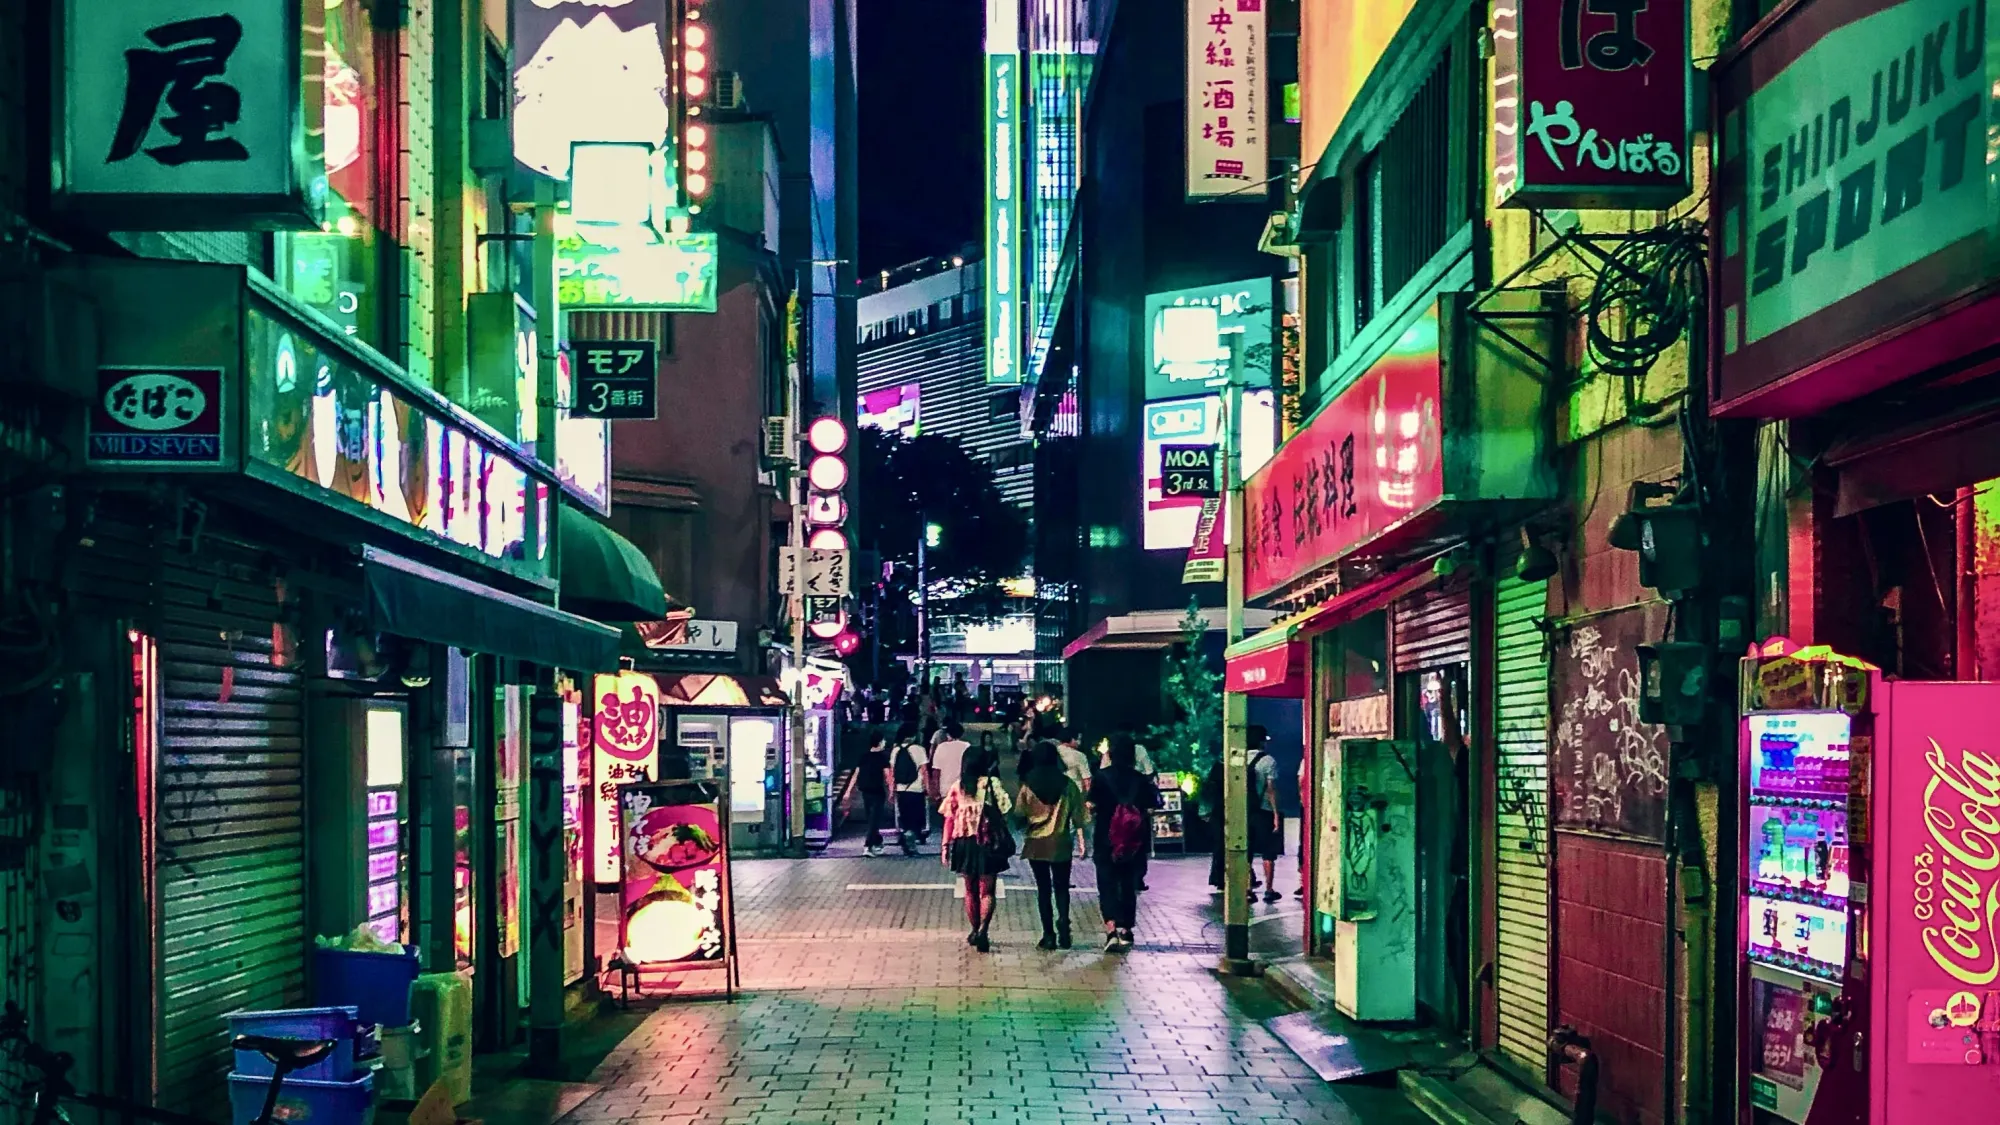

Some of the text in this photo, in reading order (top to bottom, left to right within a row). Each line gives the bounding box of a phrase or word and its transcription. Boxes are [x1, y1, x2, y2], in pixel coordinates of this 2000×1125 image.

[104, 14, 250, 166] 屋
[1202, 0, 1235, 148] 央線酒場
[1525, 99, 1682, 176] やんばる
[1751, 92, 1982, 297] SPORT
[586, 349, 645, 374] モア
[112, 382, 195, 421] たばこ
[587, 382, 645, 413] 3番街
[94, 436, 215, 456] MILD SEVEN
[1165, 449, 1210, 468] MOA
[1166, 472, 1195, 495] 3rd
[829, 550, 844, 593] うなぎ
[813, 597, 838, 608] モア
[624, 790, 652, 856] 油そば
[1921, 735, 2000, 986] Coca-Cola
